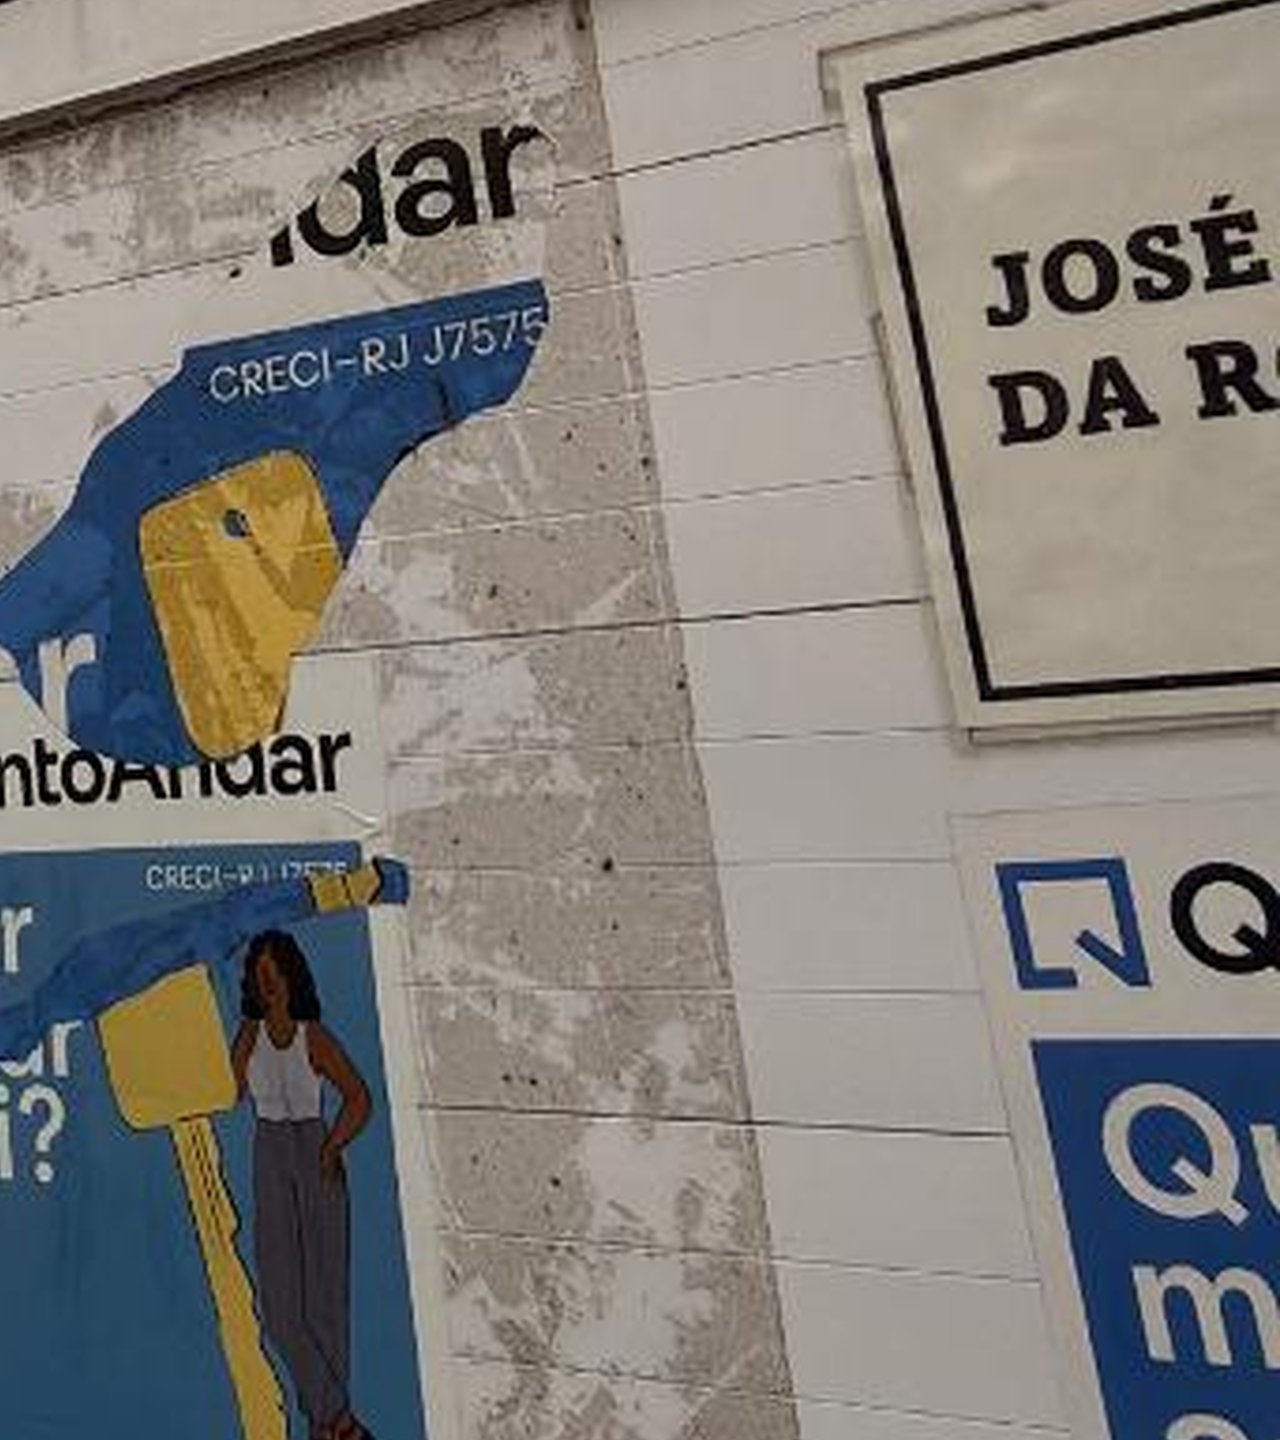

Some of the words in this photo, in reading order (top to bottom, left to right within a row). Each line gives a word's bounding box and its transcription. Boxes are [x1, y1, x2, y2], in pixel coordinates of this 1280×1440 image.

[986, 195, 1271, 327] JOSÉ
[209, 334, 411, 403] CRECI-RJ
[987, 355, 1160, 447] DA
[1186, 340, 1280, 419] R
